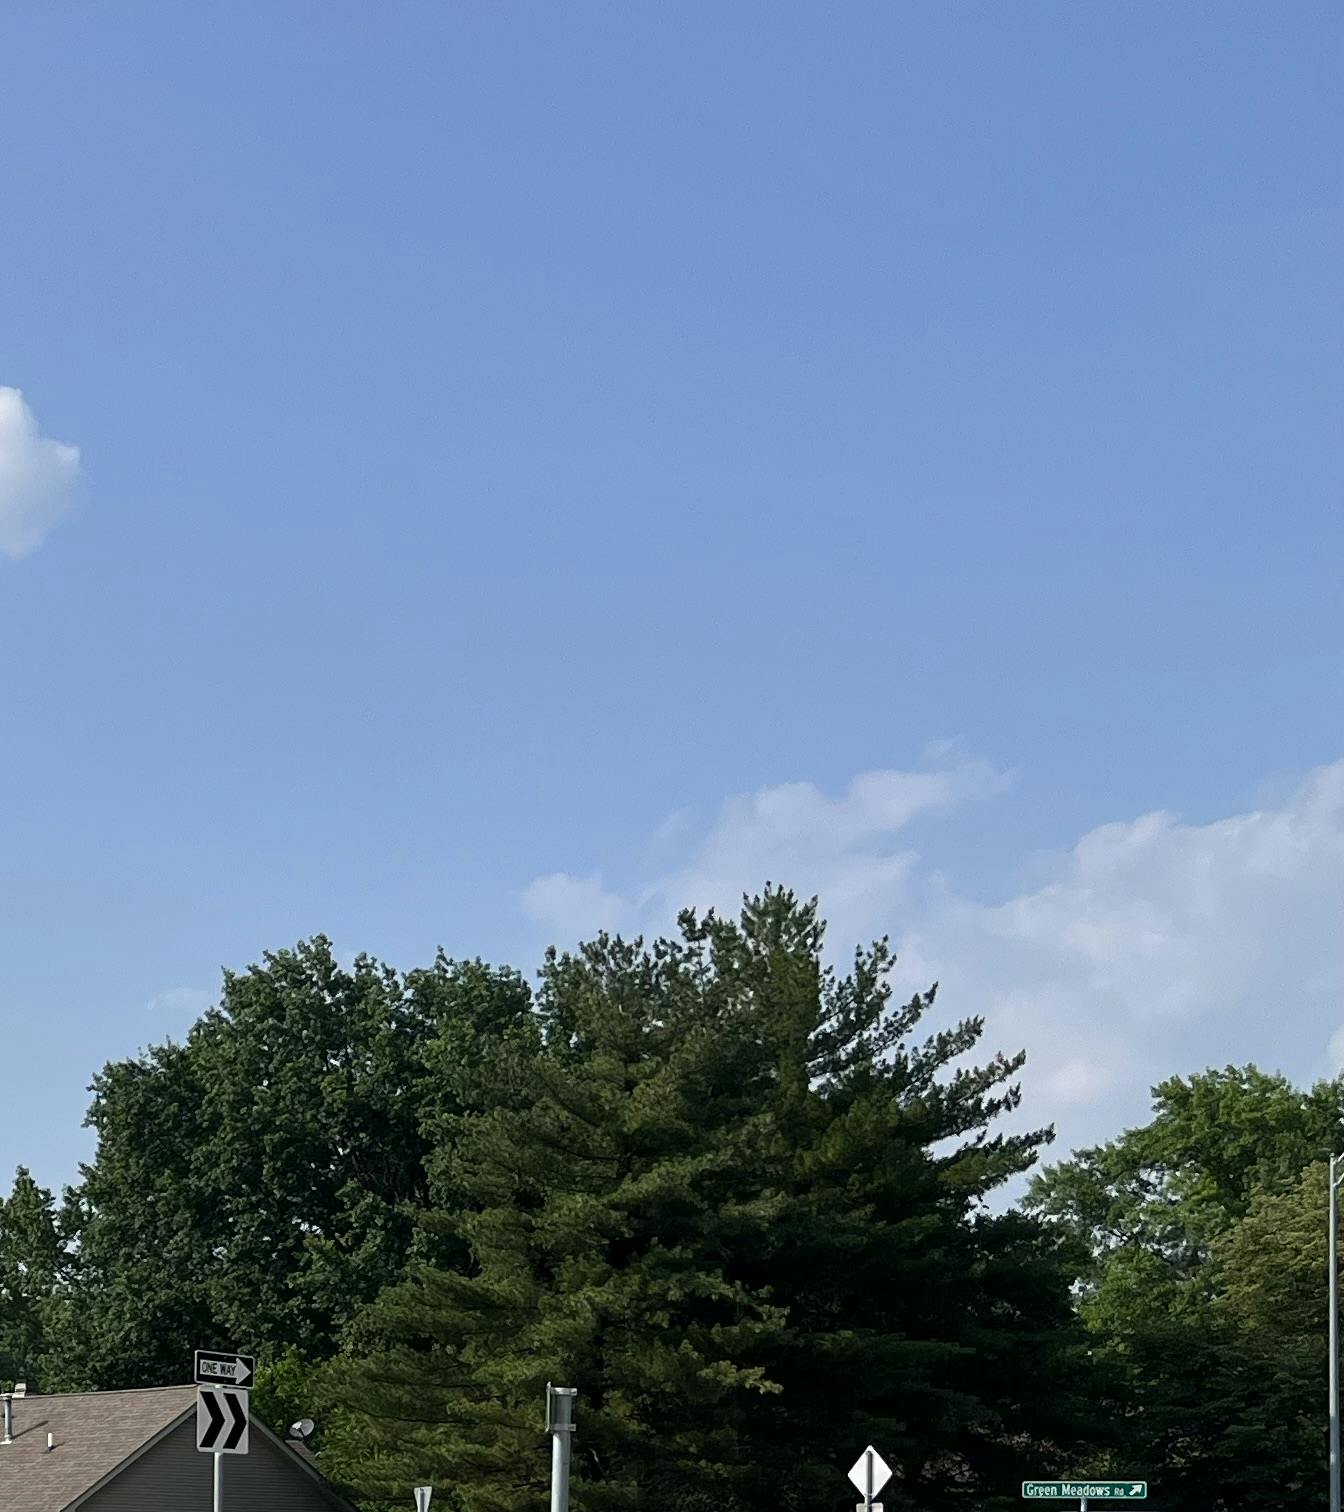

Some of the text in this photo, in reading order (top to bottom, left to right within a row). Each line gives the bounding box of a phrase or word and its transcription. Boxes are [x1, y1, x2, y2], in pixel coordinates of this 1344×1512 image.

[201, 1361, 236, 1376] ONE WAY
[1026, 1483, 1125, 1496] Green Meadows Rd
